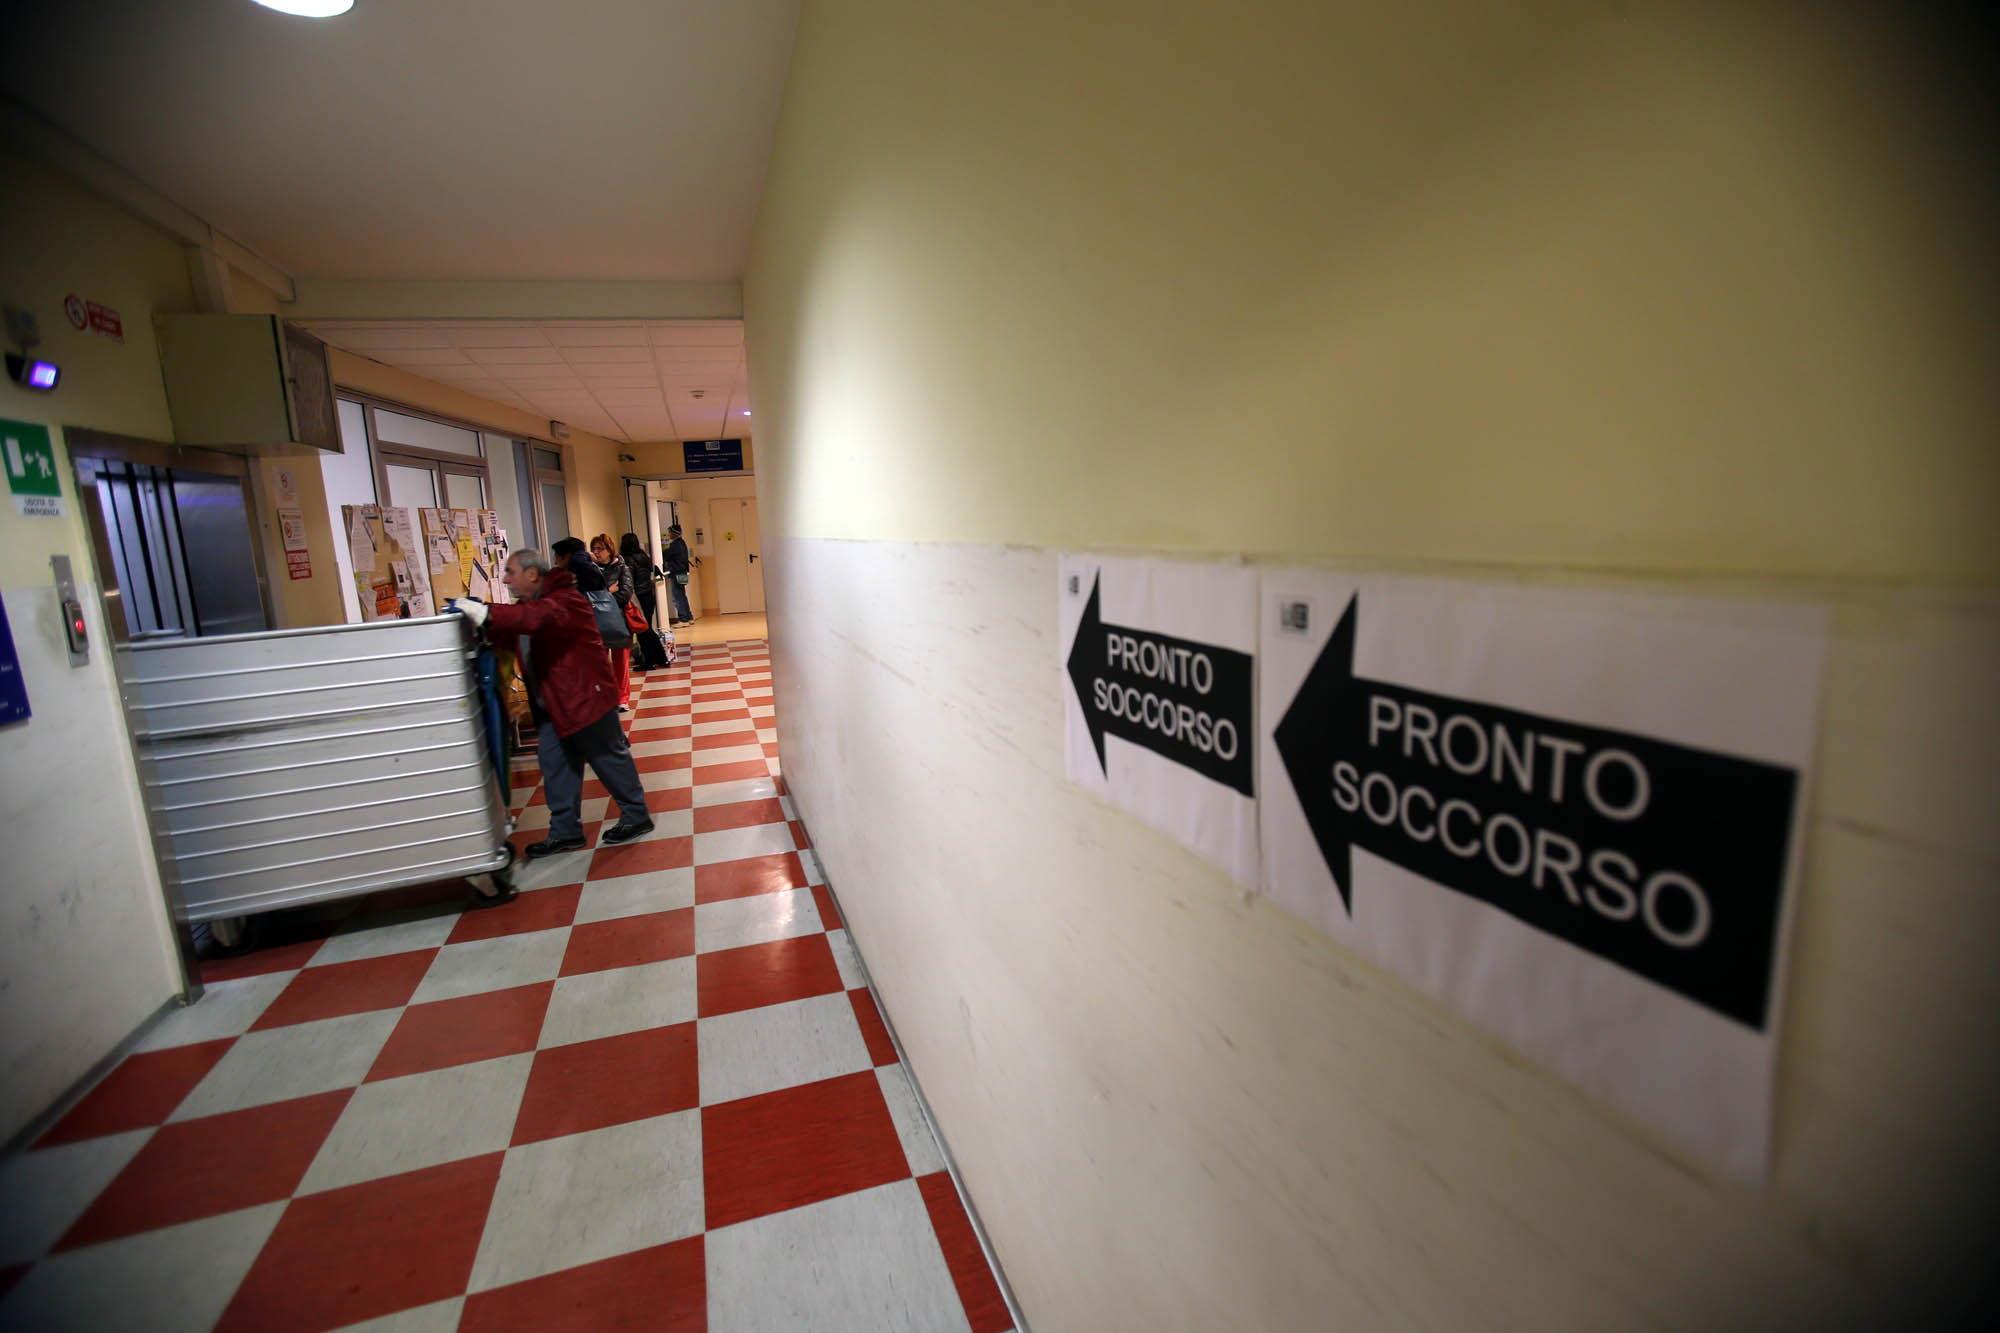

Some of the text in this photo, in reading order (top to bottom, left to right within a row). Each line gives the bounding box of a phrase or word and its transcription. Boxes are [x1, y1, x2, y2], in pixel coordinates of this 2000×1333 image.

[1107, 633, 1214, 695] PRONTO
[1094, 678, 1239, 761] SOCCORSO
[1368, 695, 1651, 822] PRONTO
[1332, 760, 1713, 948] SOCCORSO
